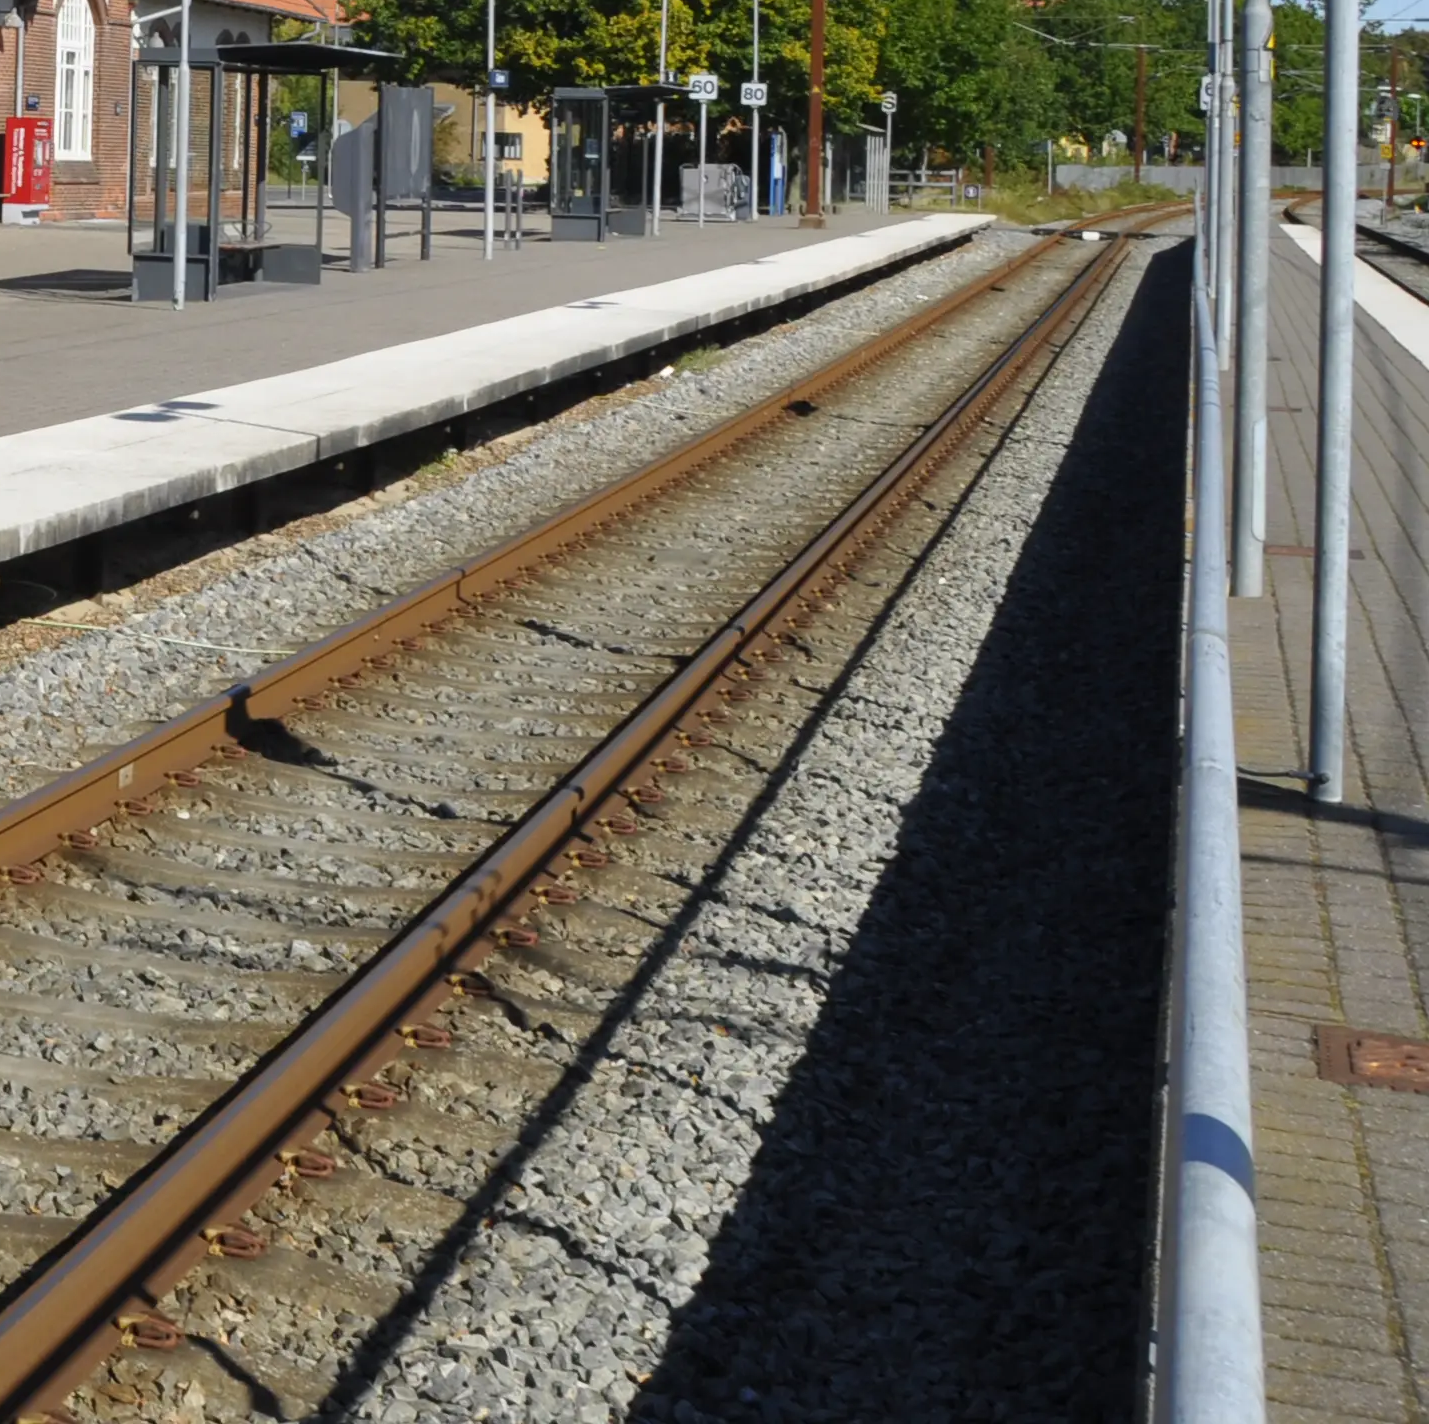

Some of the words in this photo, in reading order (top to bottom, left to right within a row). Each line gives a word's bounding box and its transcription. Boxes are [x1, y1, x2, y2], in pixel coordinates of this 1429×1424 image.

[691, 80, 715, 94] 60
[743, 87, 765, 101] 80
[883, 96, 895, 109] S
